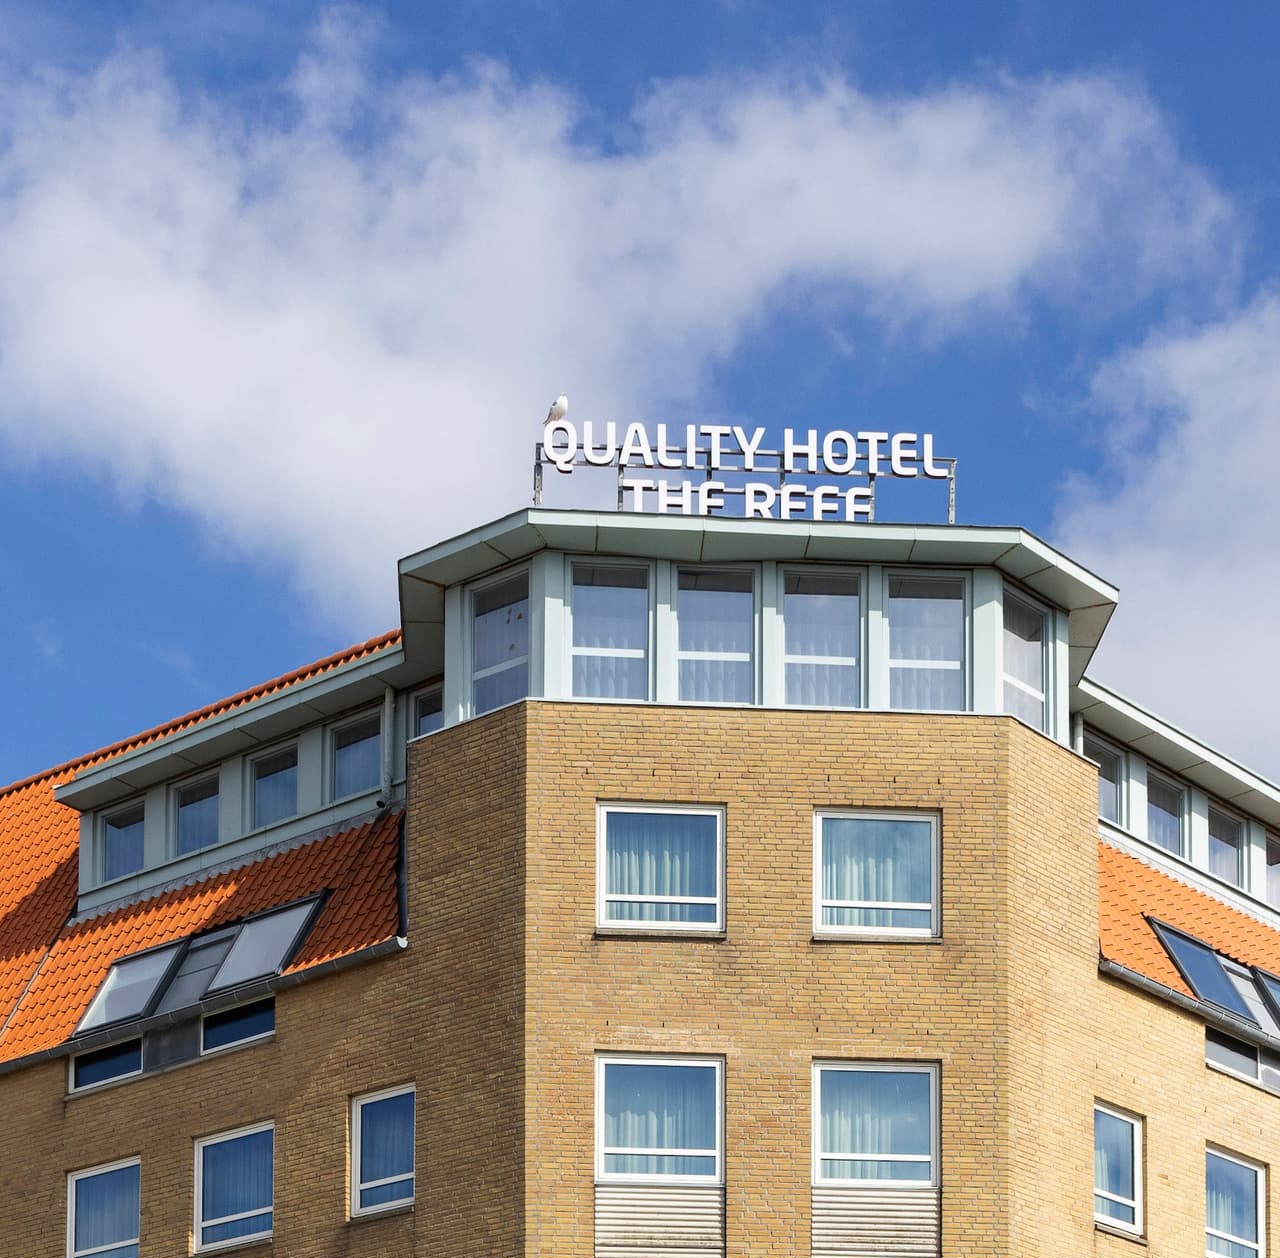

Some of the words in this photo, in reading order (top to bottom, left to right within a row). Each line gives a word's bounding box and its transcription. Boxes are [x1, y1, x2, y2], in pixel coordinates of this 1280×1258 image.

[543, 420, 766, 473] QUALITY
[783, 428, 949, 477] HOTEL
[622, 478, 726, 515] THE
